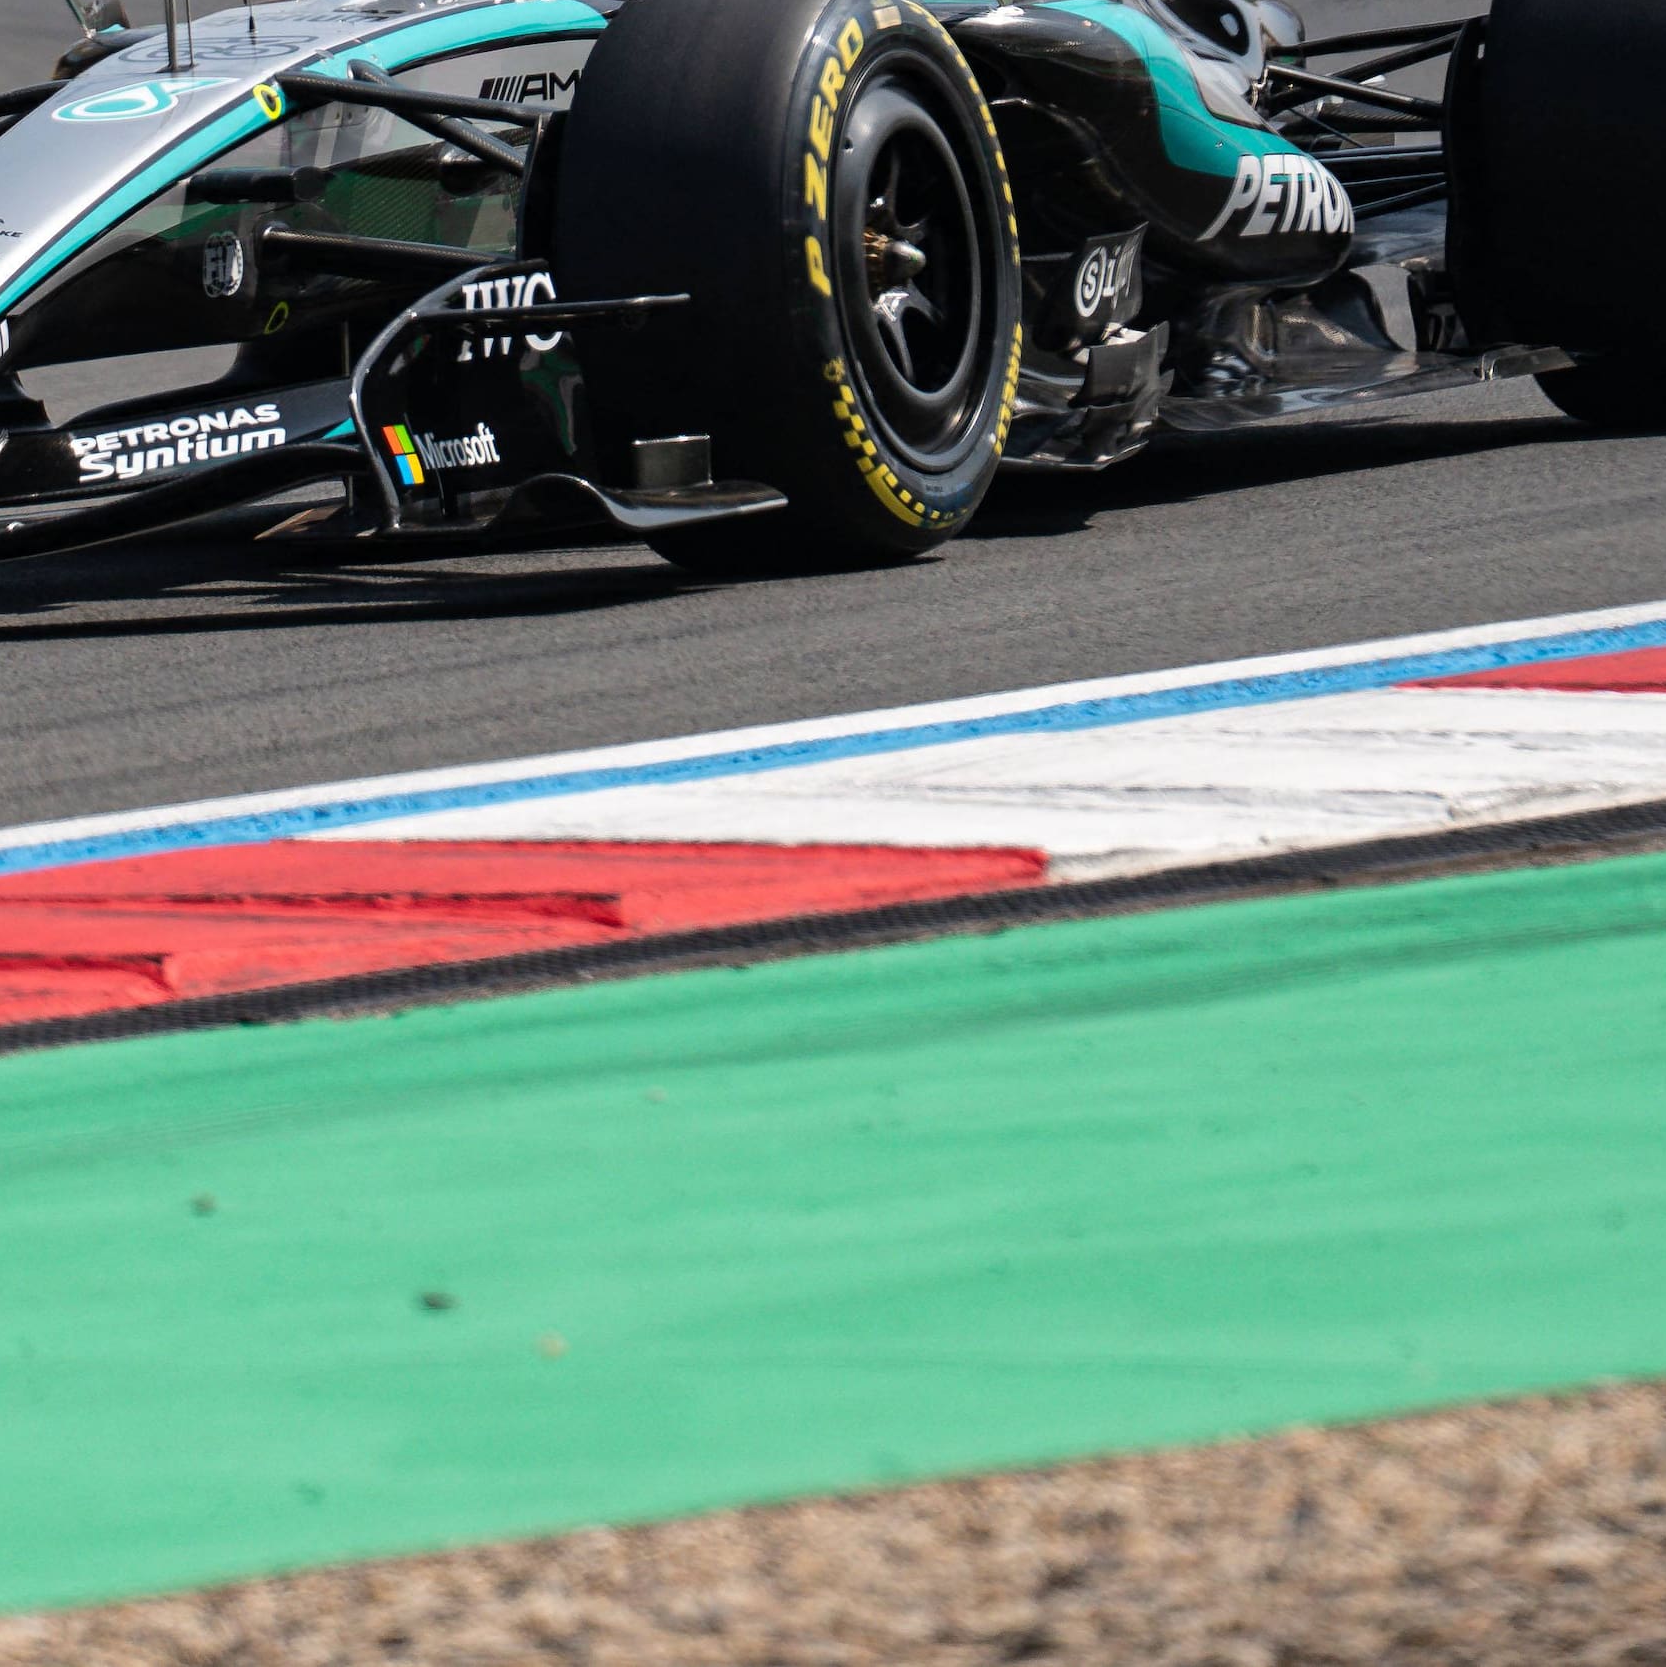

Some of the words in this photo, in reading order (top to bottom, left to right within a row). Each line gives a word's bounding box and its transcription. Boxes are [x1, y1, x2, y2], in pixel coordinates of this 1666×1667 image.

[518, 68, 584, 103] AM
[804, 16, 864, 221] ZERO
[805, 235, 832, 297] P
[70, 403, 281, 458] PETRONAS
[79, 427, 286, 482] Syntium
[413, 422, 501, 470] Microsoft
